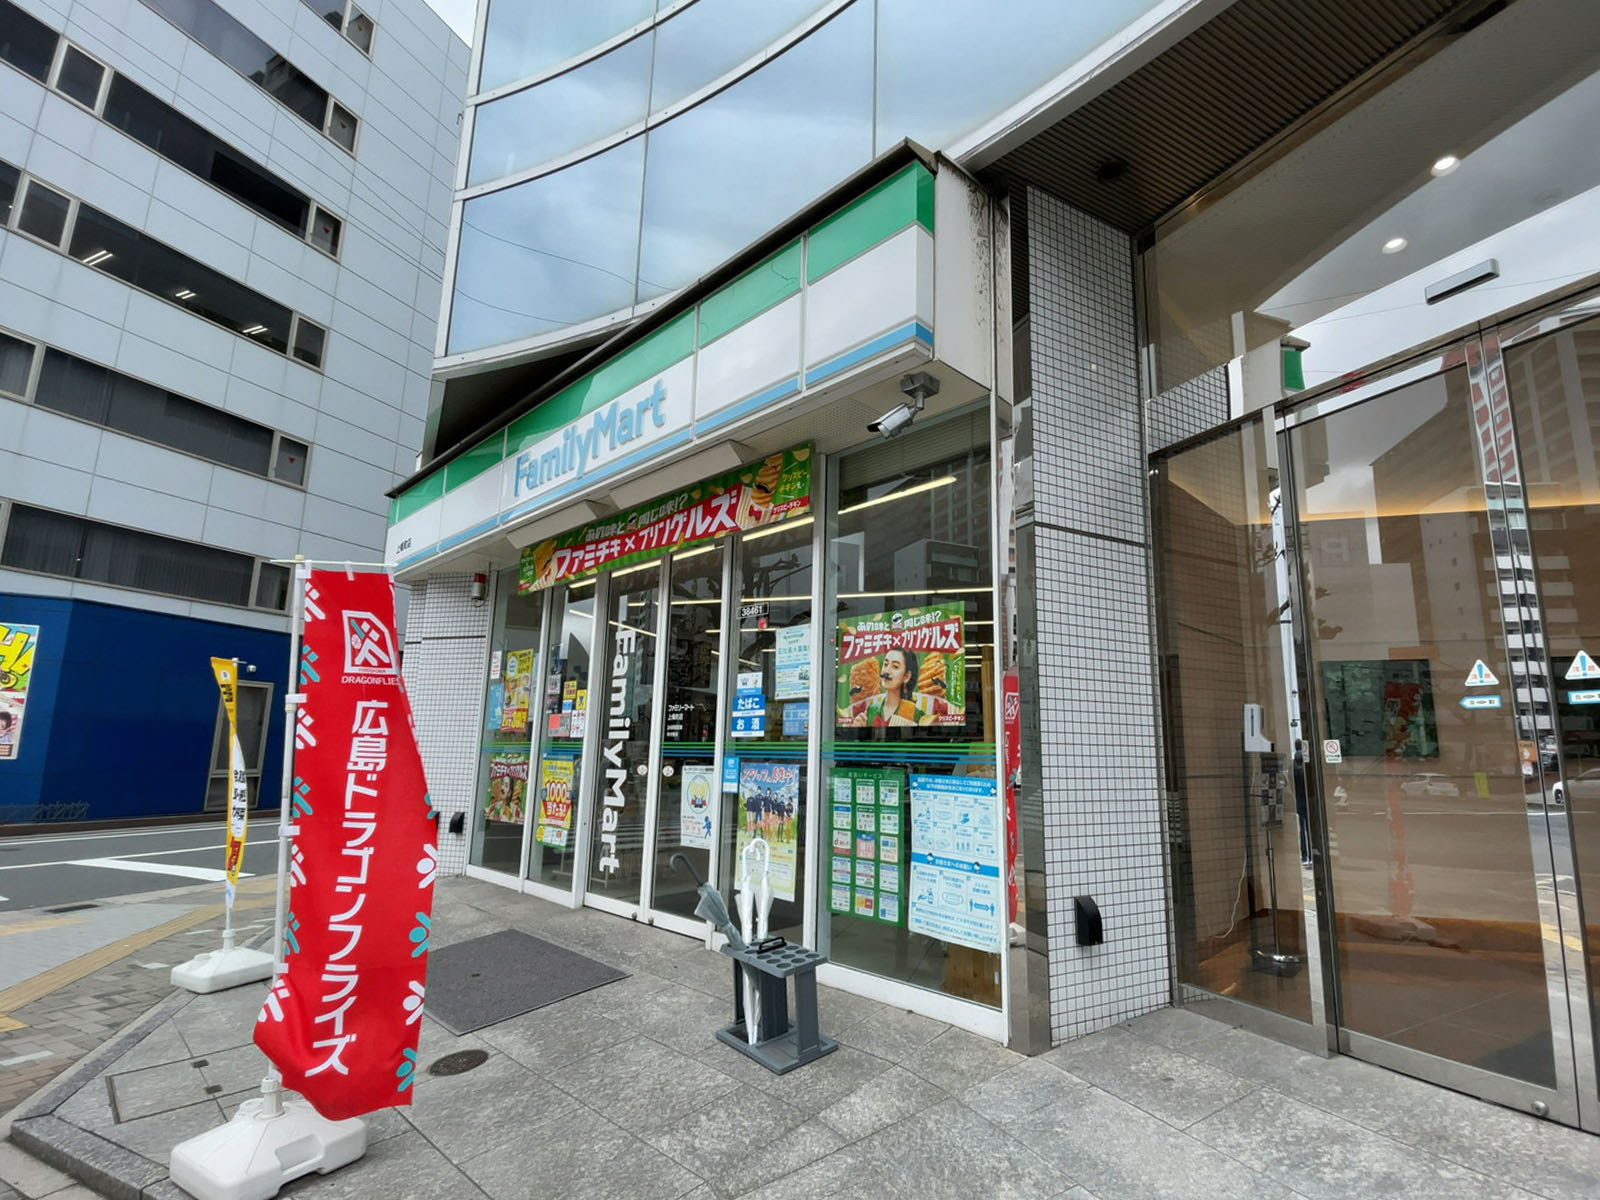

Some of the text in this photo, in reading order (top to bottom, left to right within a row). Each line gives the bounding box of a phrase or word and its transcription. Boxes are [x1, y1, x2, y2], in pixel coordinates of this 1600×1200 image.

[514, 379, 667, 497] FamilyMart
[741, 605, 763, 617] 38461
[599, 629, 636, 874] FamilyMart
[737, 697, 760, 710] たばこ
[305, 699, 390, 1078] 広島ドラゴンフライズ
